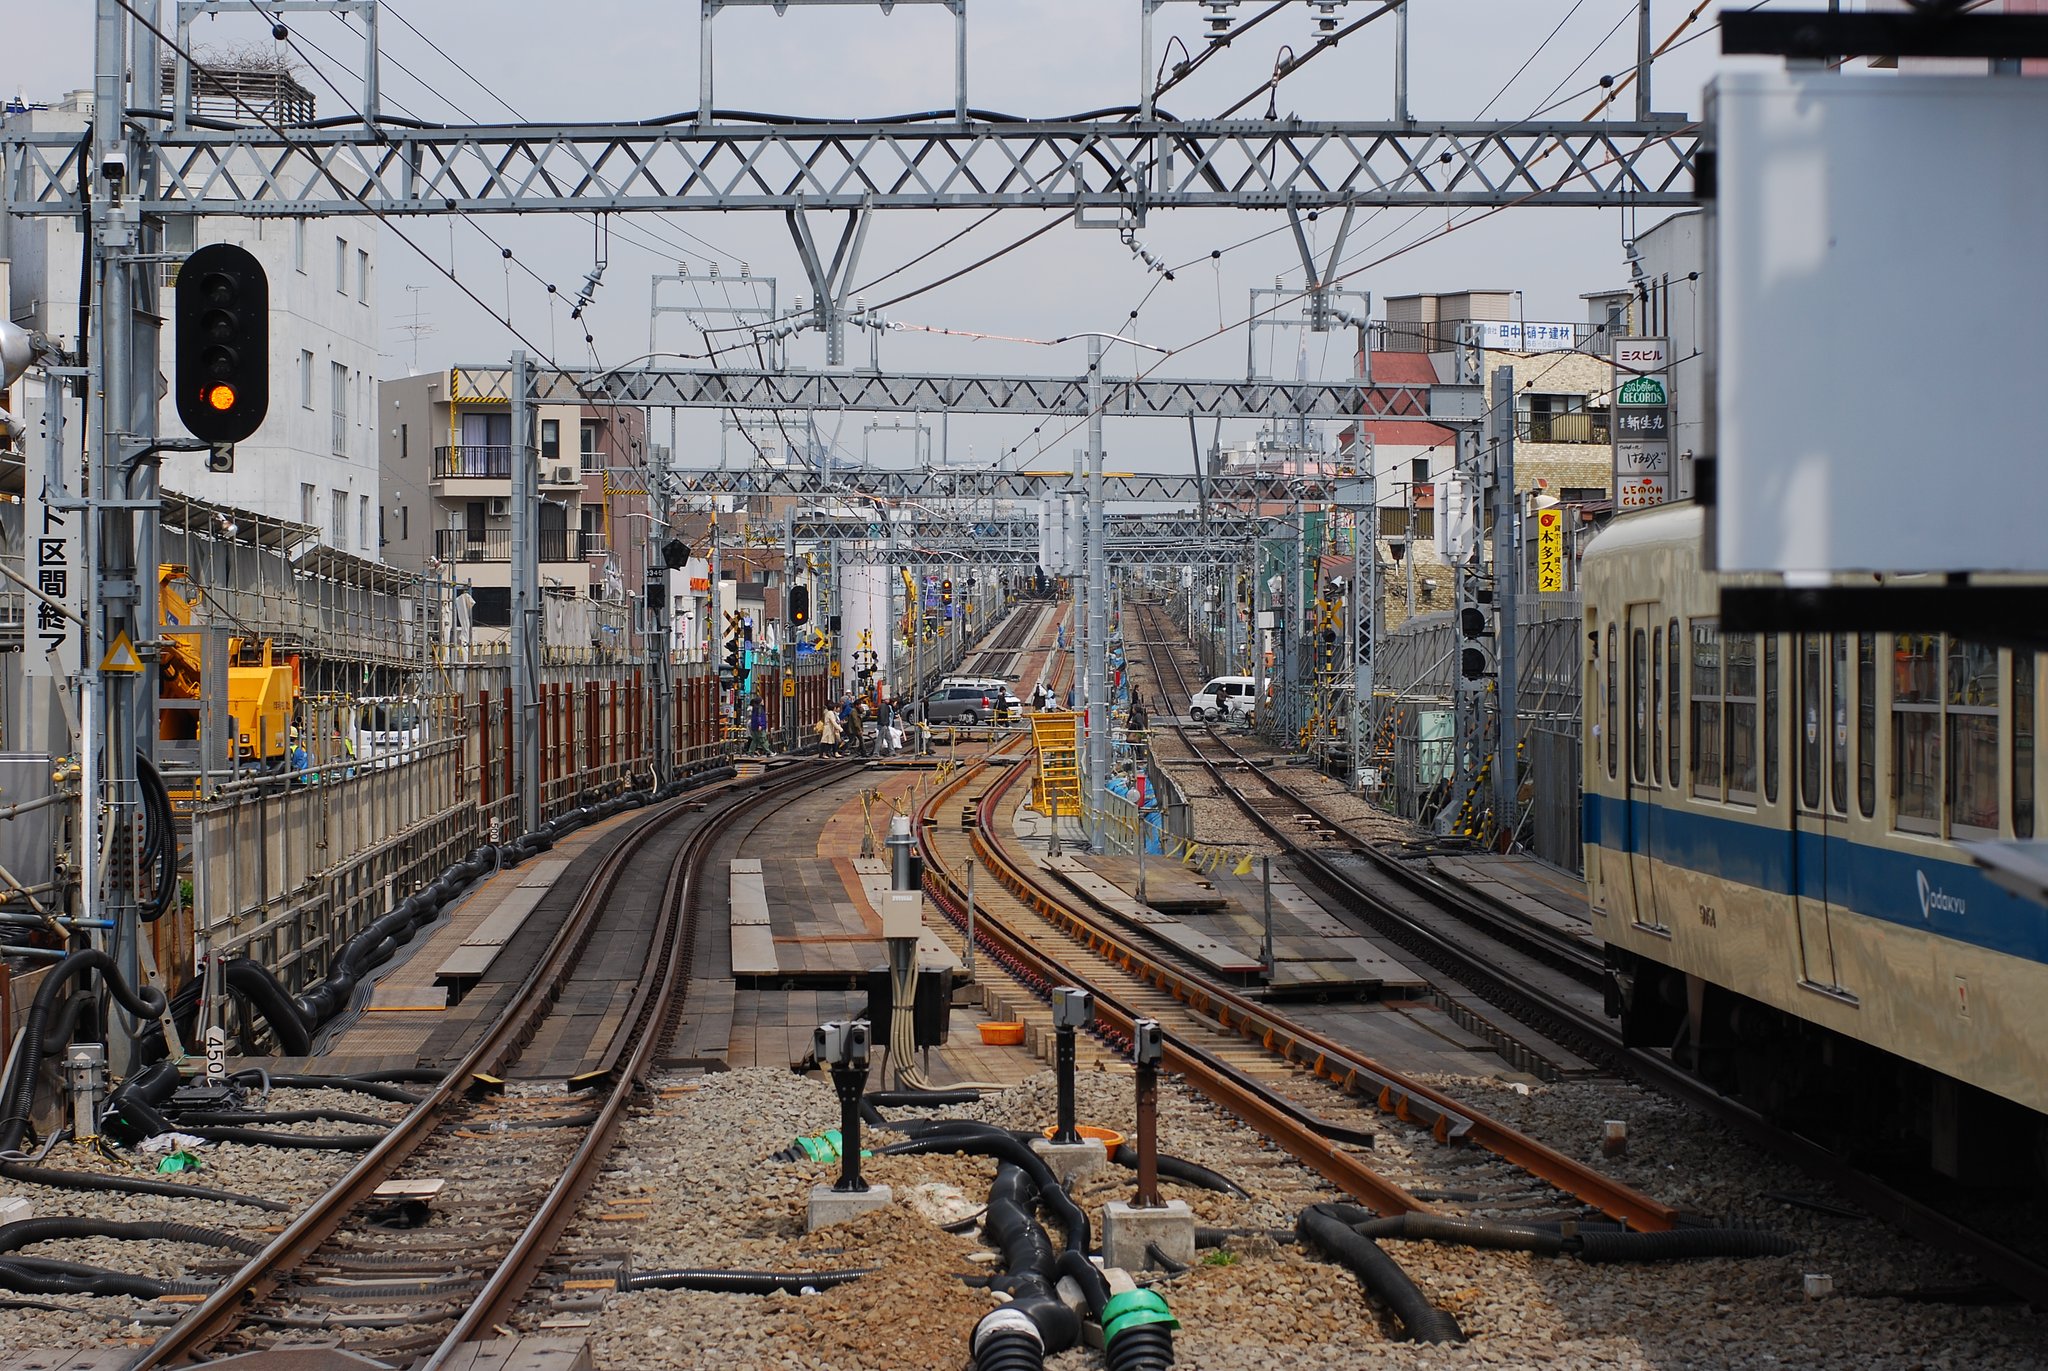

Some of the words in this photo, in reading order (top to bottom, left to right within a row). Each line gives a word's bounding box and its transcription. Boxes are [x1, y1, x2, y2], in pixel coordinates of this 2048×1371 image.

[1621, 350, 1662, 361] 三久ビル
[1623, 392, 1662, 403] RECORDS
[212, 442, 232, 471] 3
[1623, 486, 1663, 495] LEMON
[1623, 497, 1663, 505] GLASS
[1541, 530, 1554, 589] 本多スタ
[831, 665, 837, 673] 4
[785, 683, 792, 692] 5
[207, 1037, 224, 1073] 450
